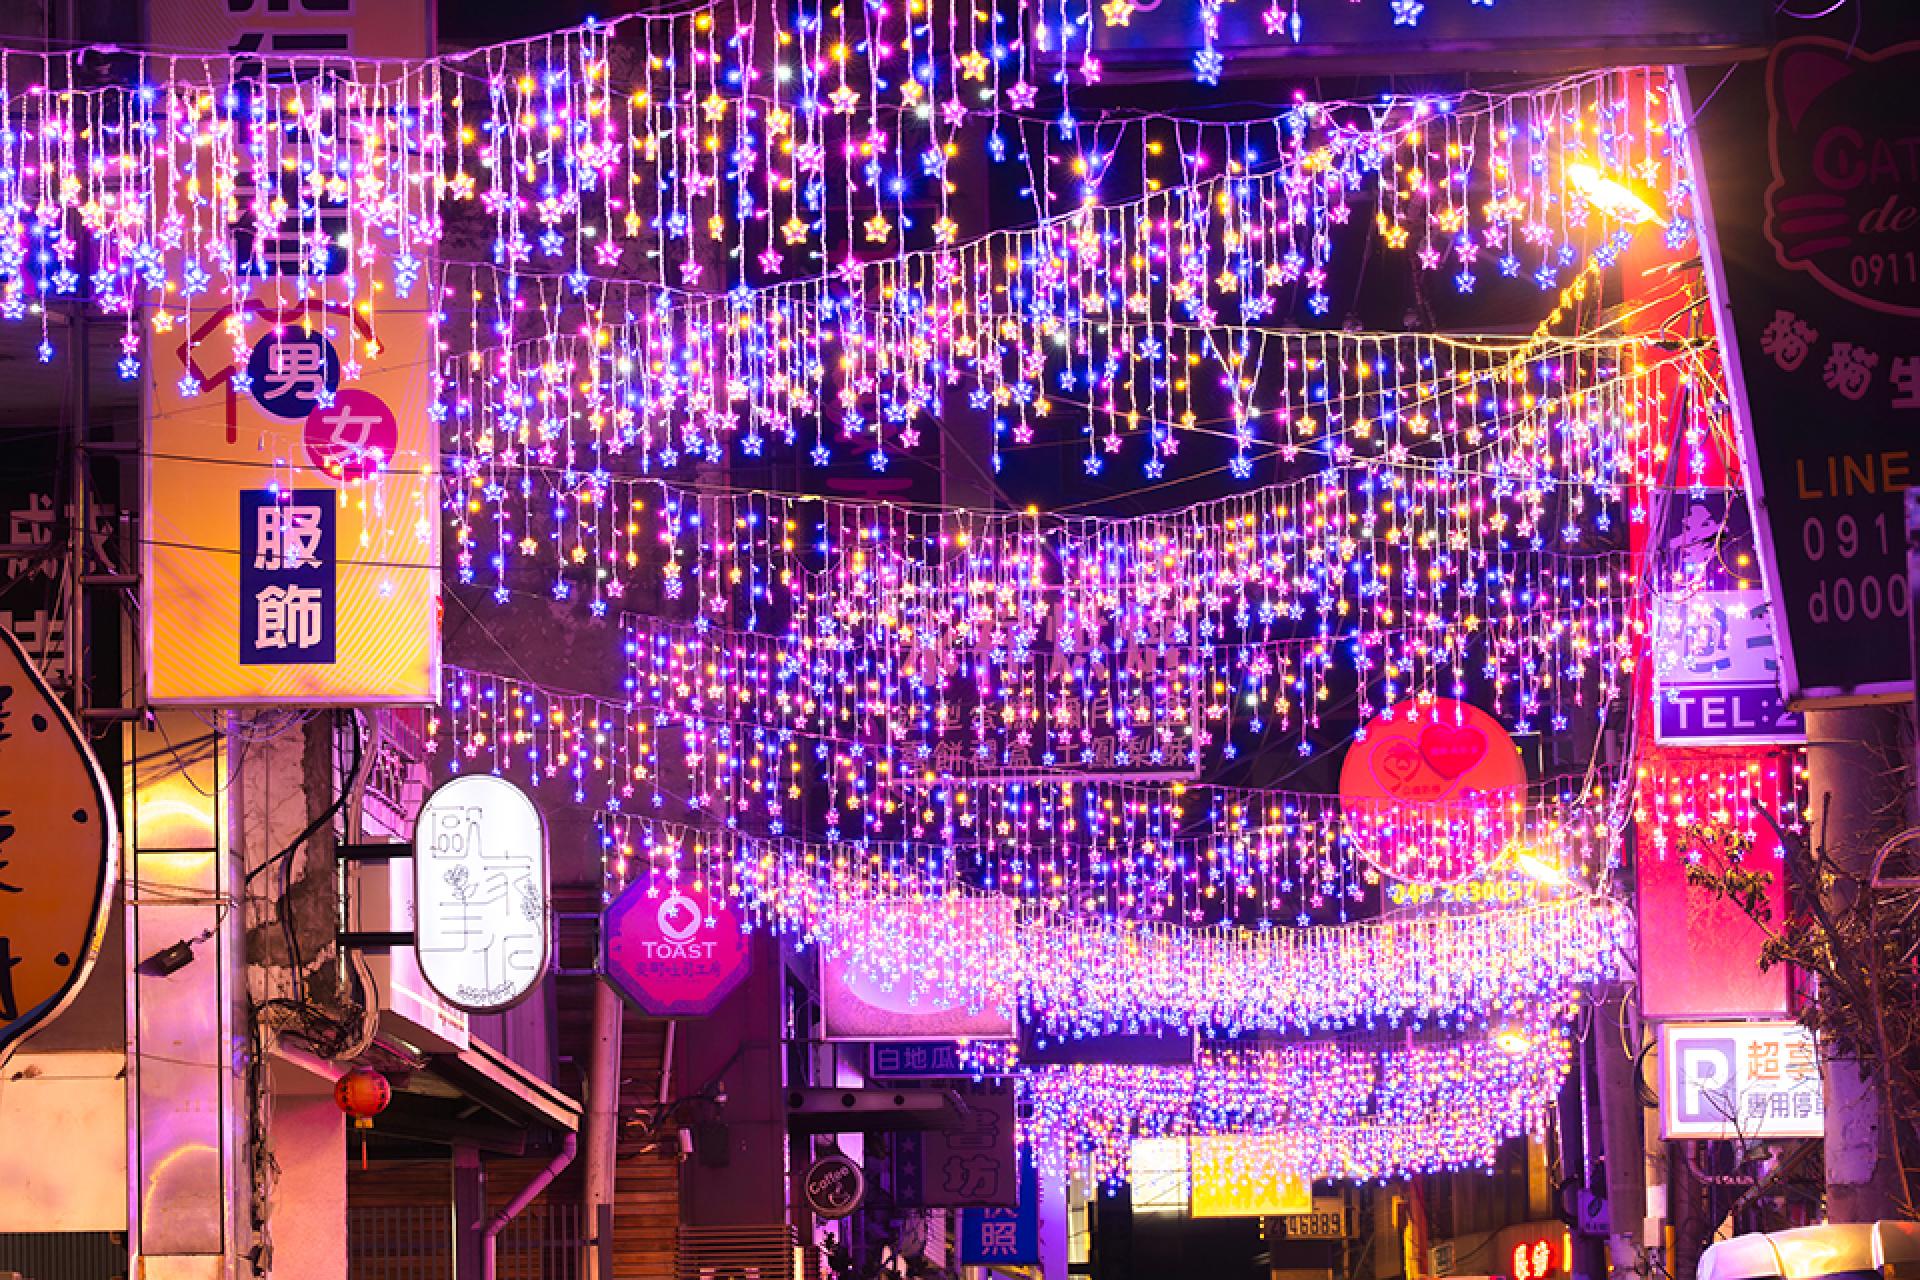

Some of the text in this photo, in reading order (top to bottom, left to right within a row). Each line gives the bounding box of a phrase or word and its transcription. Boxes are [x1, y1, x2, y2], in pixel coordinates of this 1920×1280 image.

[263, 343, 324, 401] 男
[322, 405, 383, 463] 女
[1796, 449, 1911, 500] LINE
[1802, 511, 1889, 562] 091
[254, 504, 323, 649] 服飾
[641, 940, 719, 959] TOAST
[1683, 1047, 1729, 1116] P
